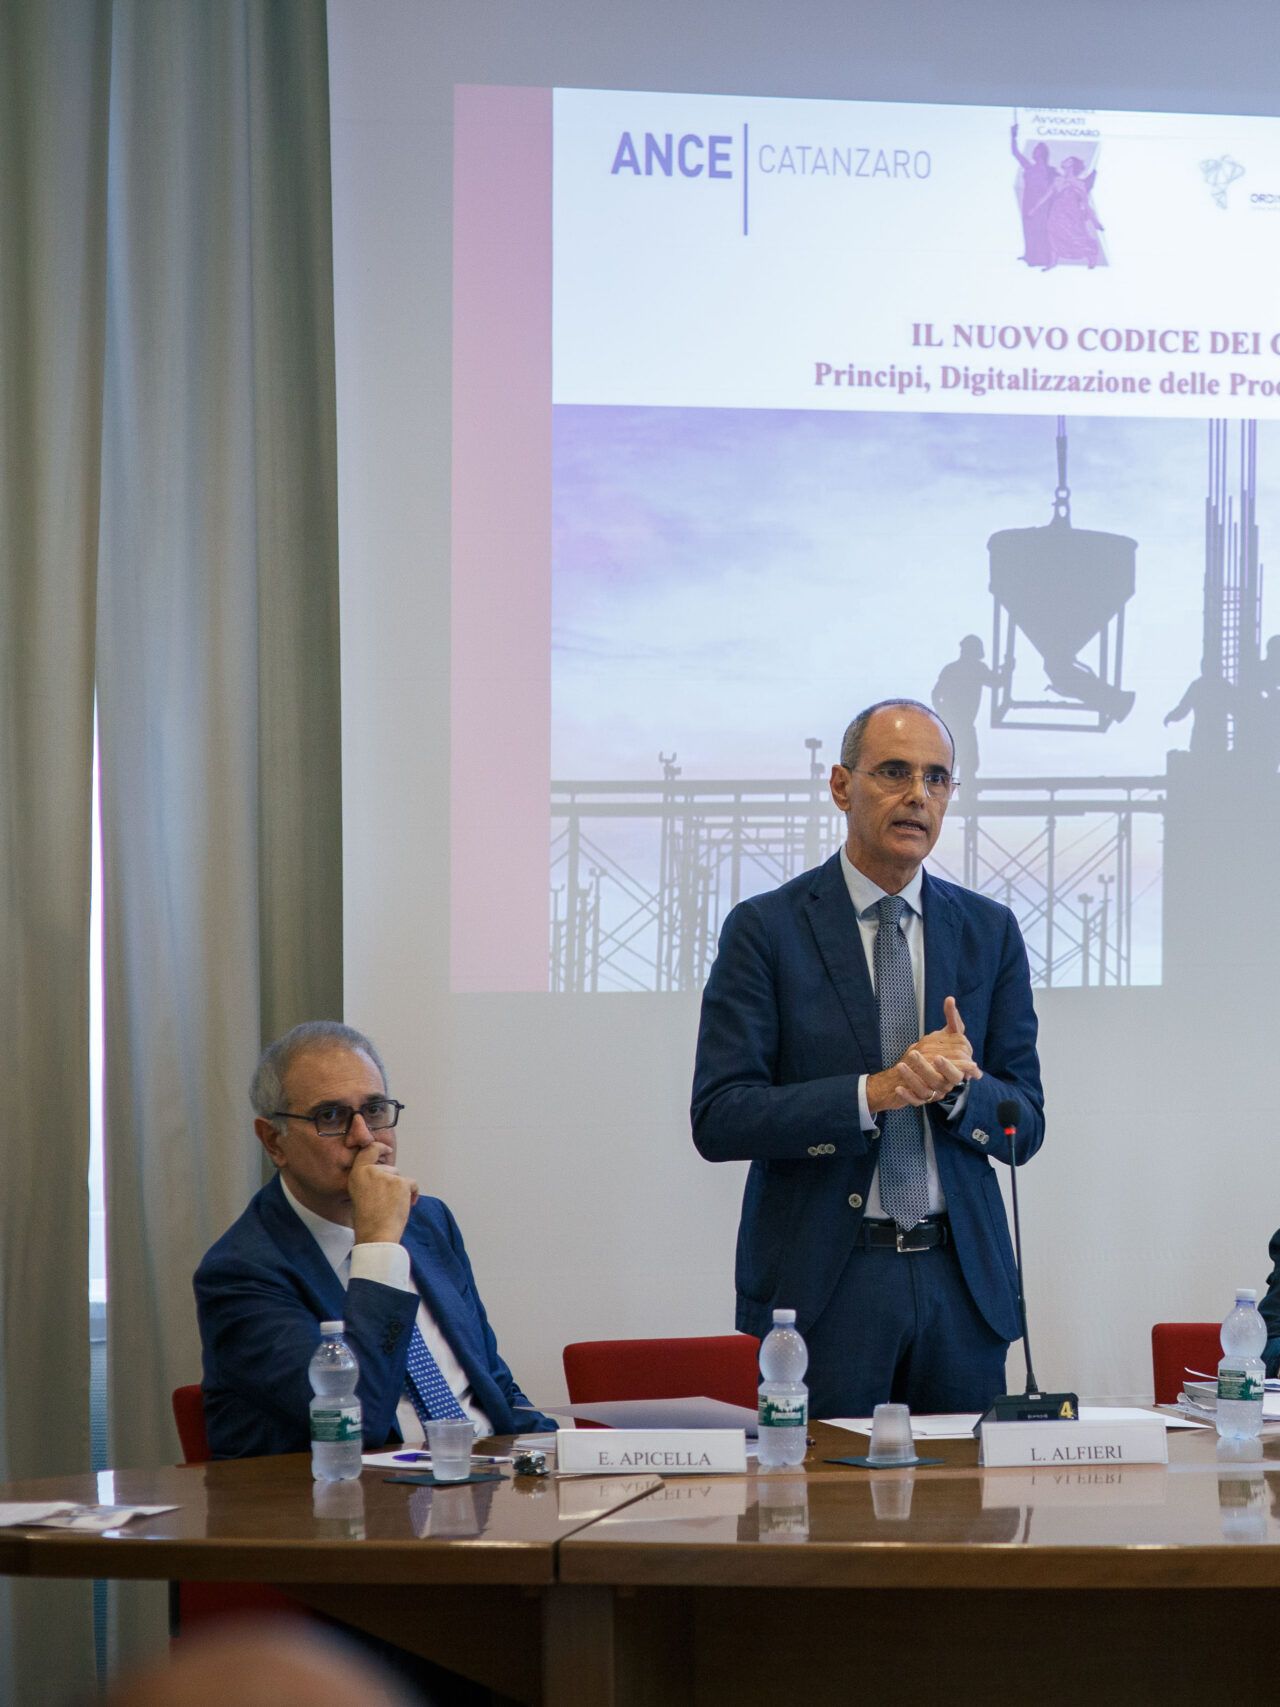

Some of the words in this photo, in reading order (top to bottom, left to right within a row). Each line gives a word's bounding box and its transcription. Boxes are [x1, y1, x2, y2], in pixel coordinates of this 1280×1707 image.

[611, 131, 734, 180] ANCE
[758, 143, 932, 180] CATANZARO
[912, 322, 944, 347] IL
[952, 324, 1069, 351] NUOVO
[1077, 327, 1200, 354] CODICE
[1209, 330, 1261, 356] DEI
[814, 362, 931, 394] Principi,
[940, 365, 1152, 396] Digitalizzazione
[1159, 371, 1220, 396] delle
[1060, 1401, 1073, 1419] 4
[598, 1452, 614, 1466] E.
[620, 1452, 711, 1466] APICELLA
[1031, 1448, 1046, 1461] L.
[1052, 1446, 1122, 1460] ALFIERI
